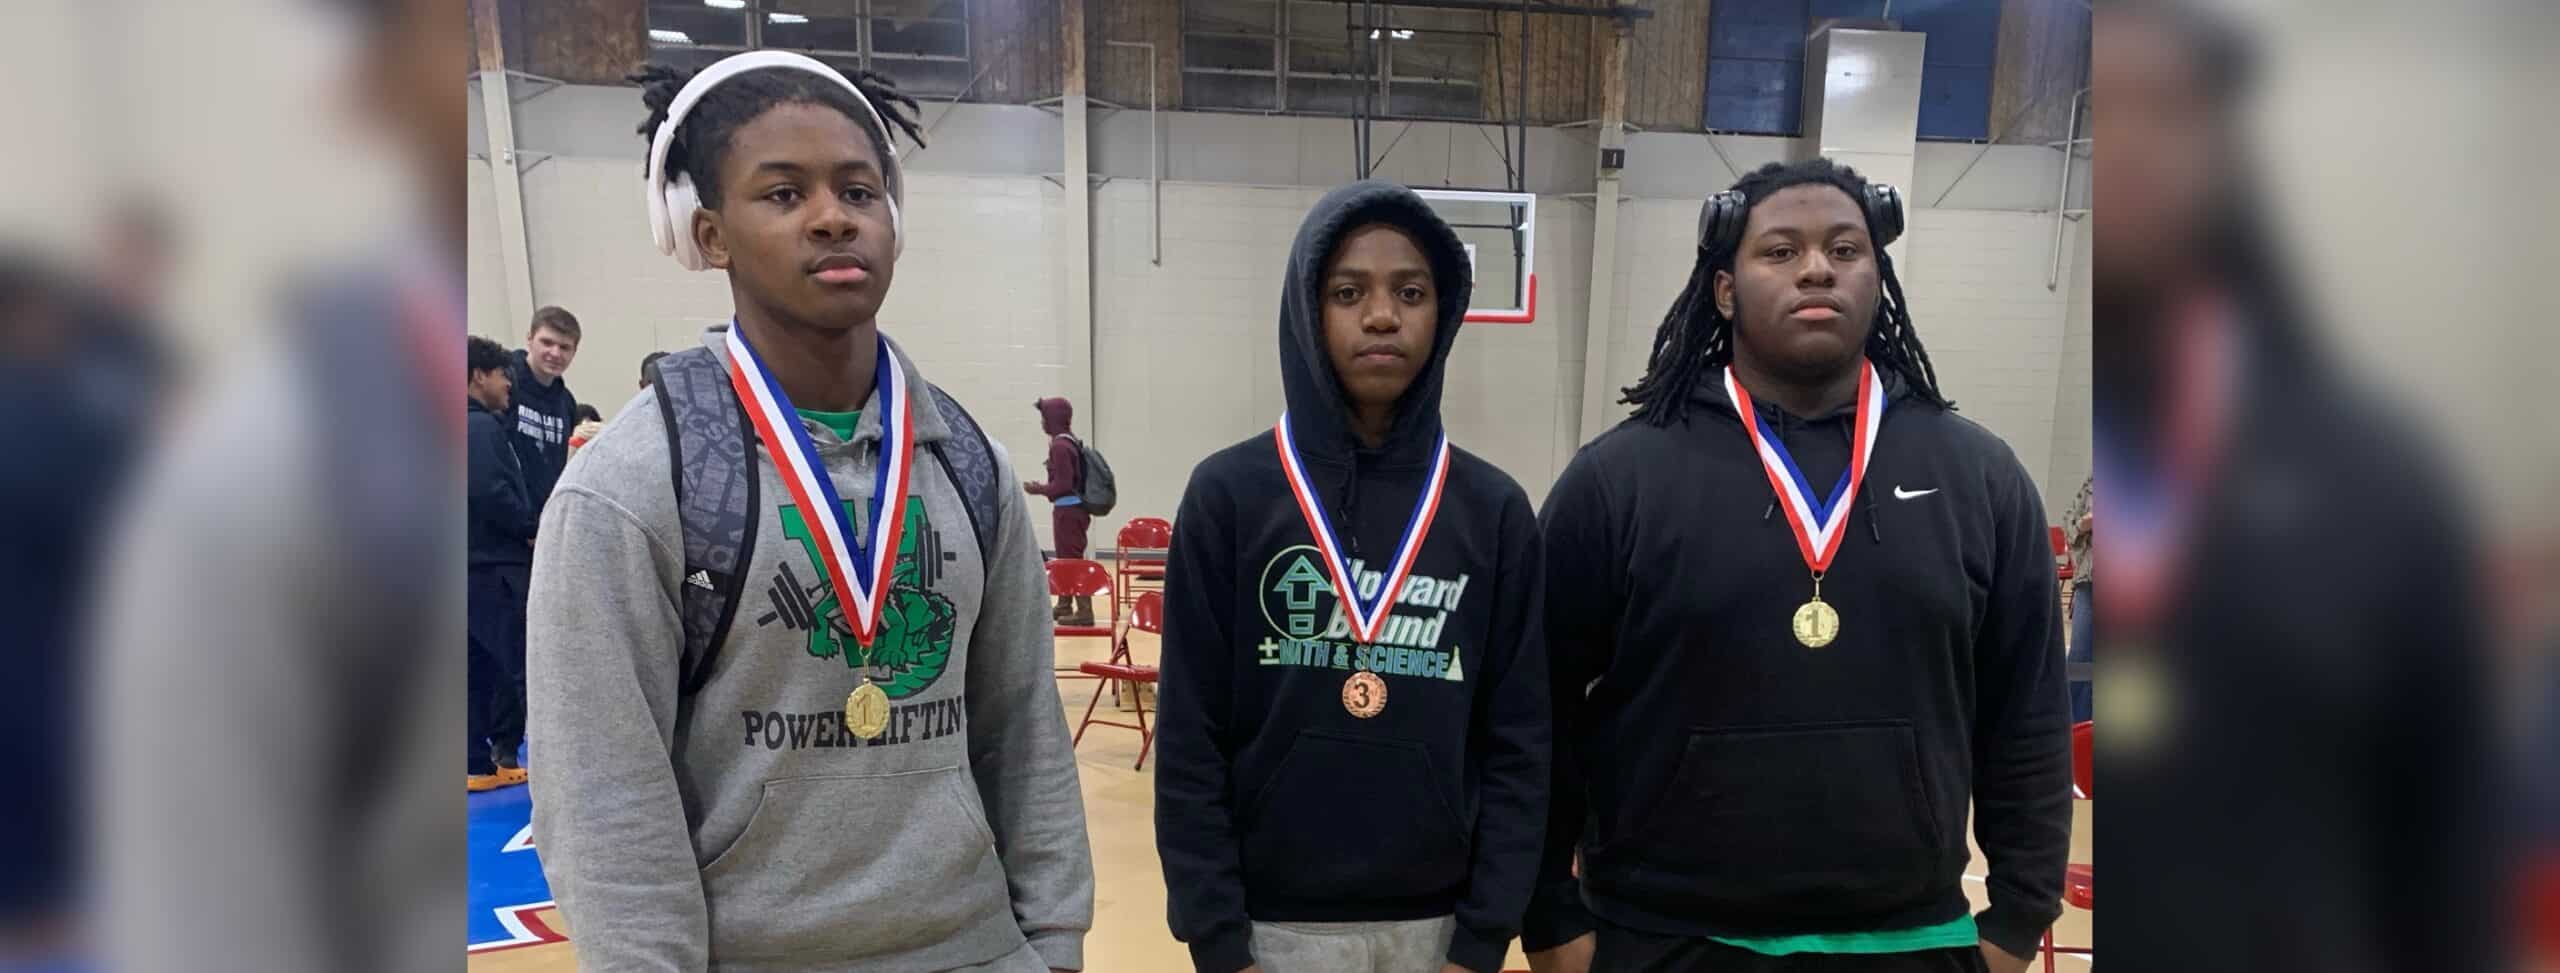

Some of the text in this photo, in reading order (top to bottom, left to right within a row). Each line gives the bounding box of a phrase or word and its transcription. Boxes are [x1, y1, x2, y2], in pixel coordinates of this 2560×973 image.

[1326, 598, 1447, 648] Bund
[1354, 645, 1449, 678] SCIENCE
[1354, 681, 1370, 709] 3
